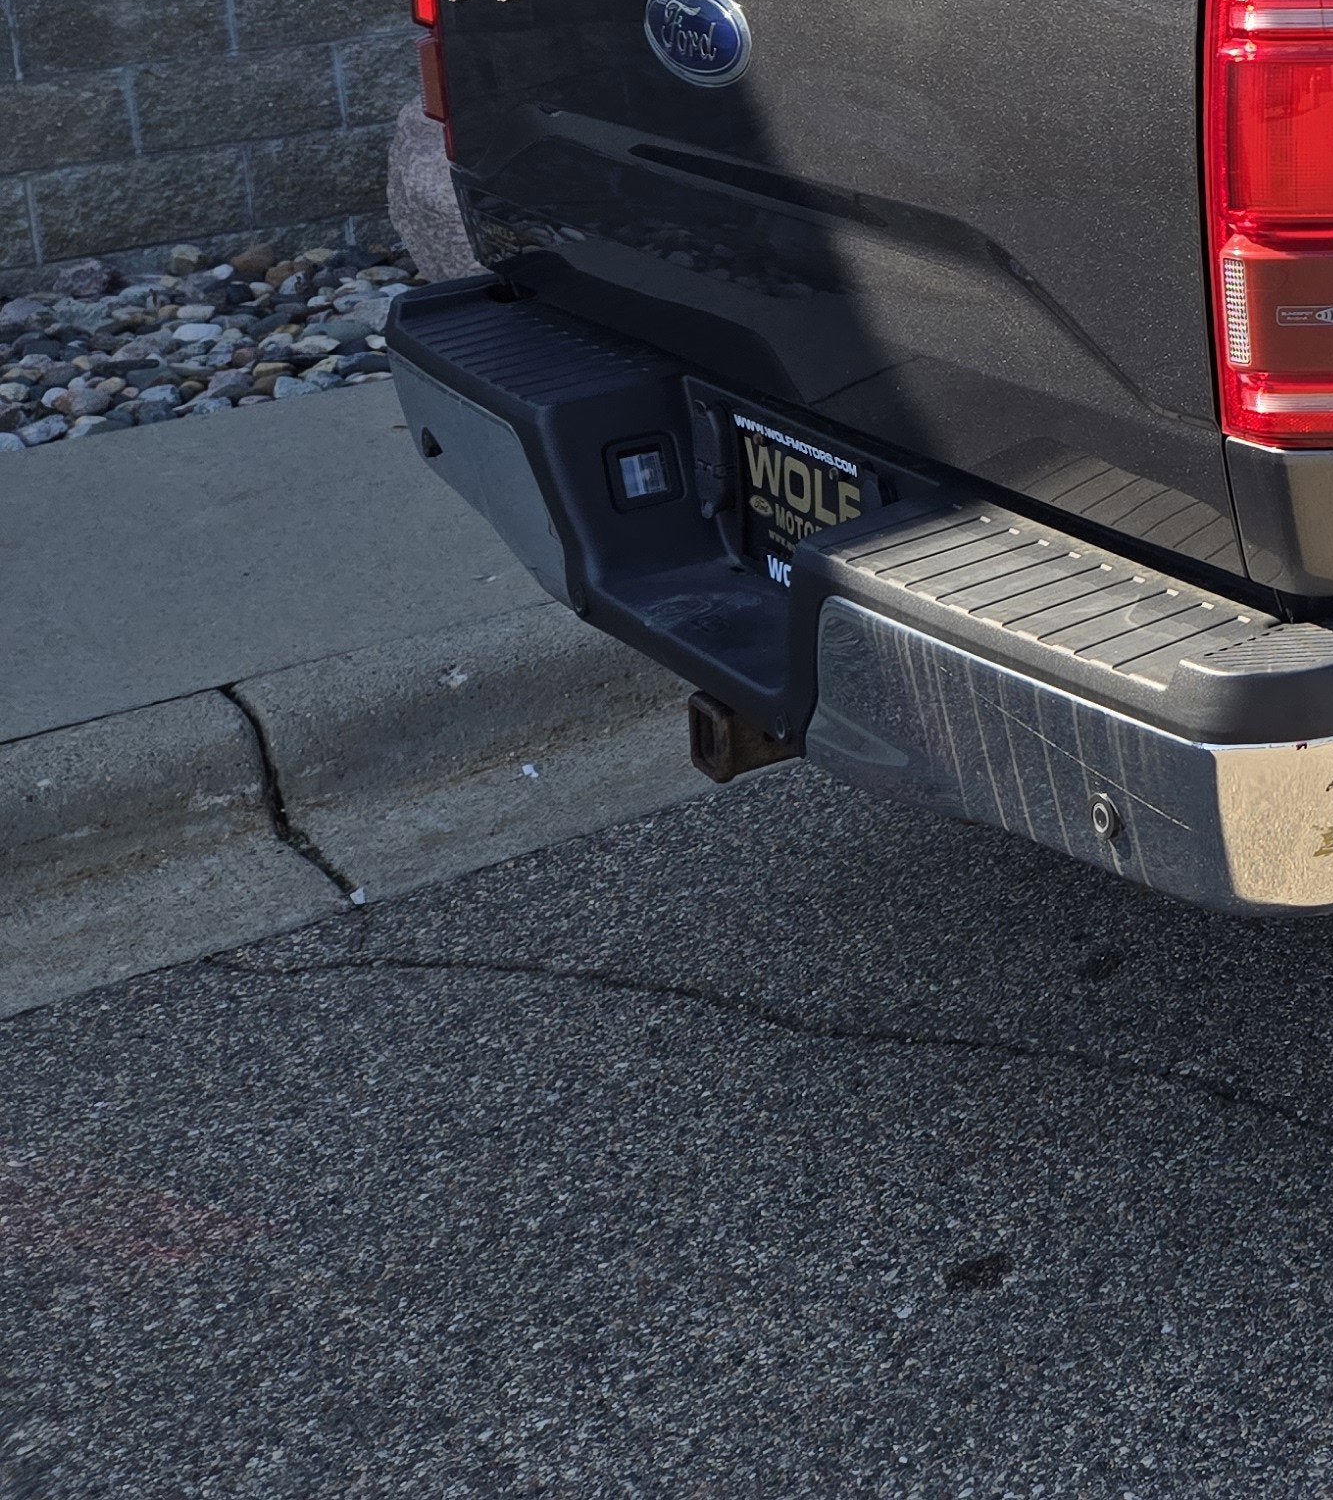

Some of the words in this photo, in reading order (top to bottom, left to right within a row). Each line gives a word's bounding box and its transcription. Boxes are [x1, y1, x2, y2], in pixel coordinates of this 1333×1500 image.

[662, 0, 717, 62] Ford
[733, 413, 858, 478] WWW.WOLFMOTORS.COM
[744, 436, 861, 526] WOLF
[775, 503, 822, 540] MOTO
